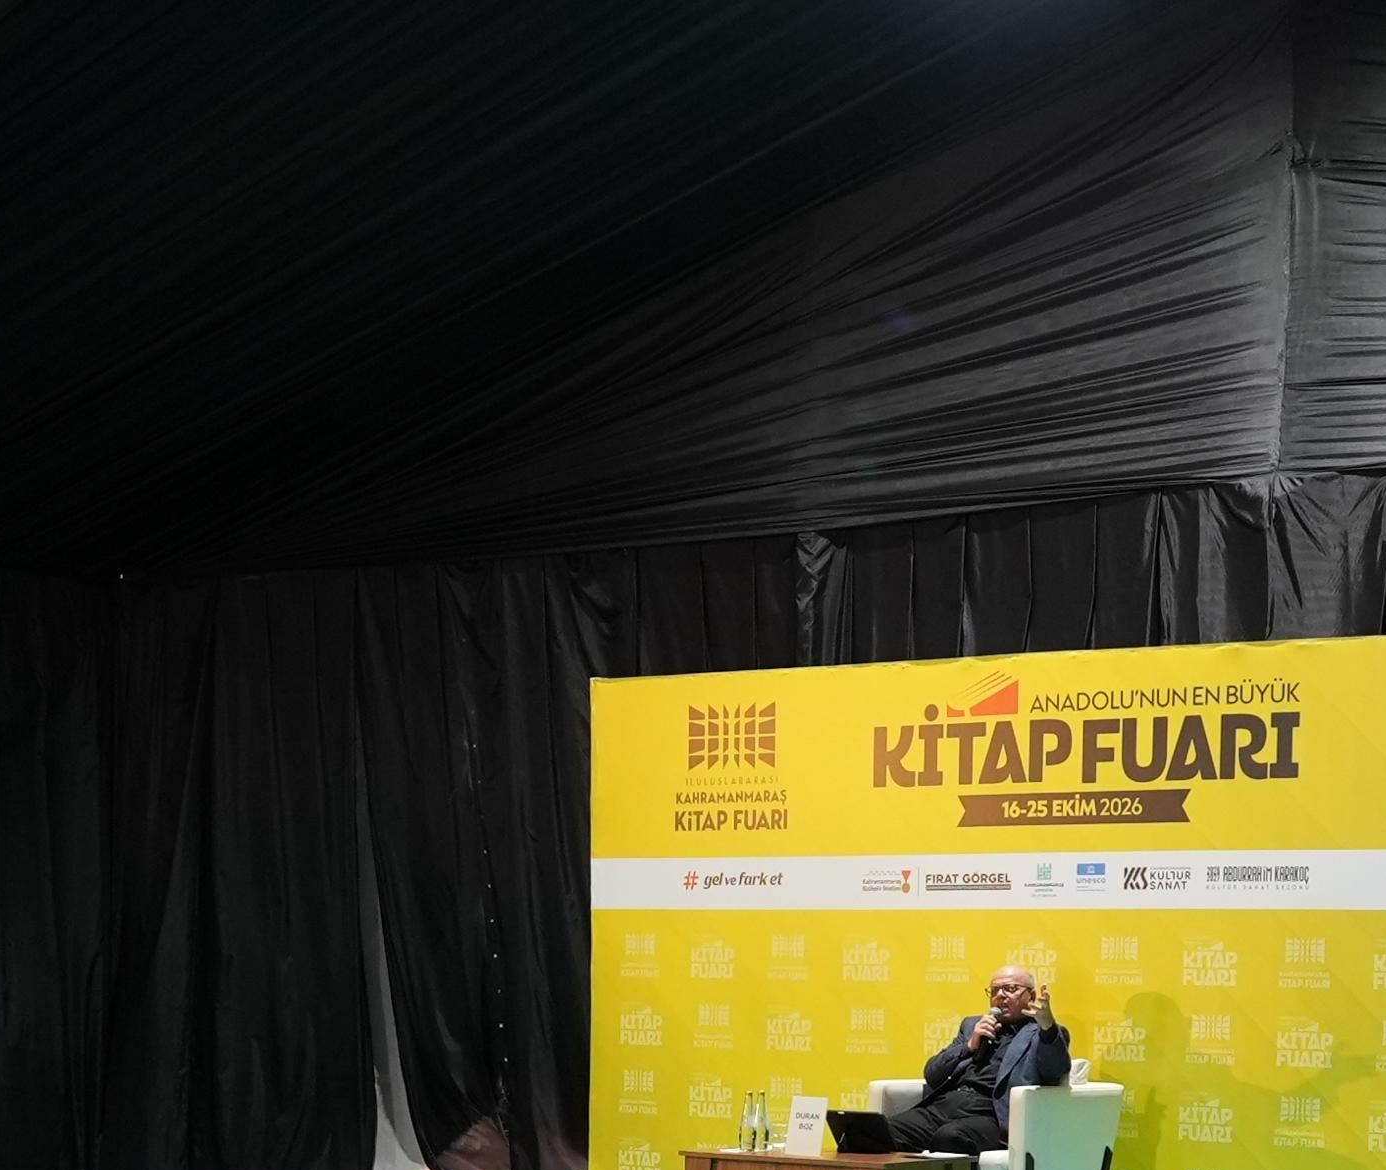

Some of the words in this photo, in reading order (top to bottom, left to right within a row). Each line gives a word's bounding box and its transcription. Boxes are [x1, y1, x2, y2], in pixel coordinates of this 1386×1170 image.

[1029, 688, 1187, 714] ANADOLU'NUN
[1192, 686, 1224, 706] EN
[1225, 678, 1300, 705] BÜYÜK
[872, 703, 1073, 788] KİTAP
[1081, 711, 1301, 785] FUARI
[675, 789, 788, 806] KAHRAMANMARAŞ
[1001, 800, 1048, 820] 16-25
[1051, 793, 1098, 818] EKİM
[1099, 797, 1143, 816] 2026
[733, 808, 789, 831] FUARI
[738, 871, 769, 886] fark
[770, 872, 784, 886] et
[925, 873, 959, 884] FIRAT
[962, 871, 1012, 884] GÖRGEL
[1149, 881, 1188, 890] SANAT
[1182, 969, 1237, 987] FUARI
[1093, 1043, 1146, 1062] FUARI
[1276, 1050, 1333, 1069] FUARI
[795, 1112, 820, 1120] DURAN
[1178, 1124, 1233, 1144] FUARI
